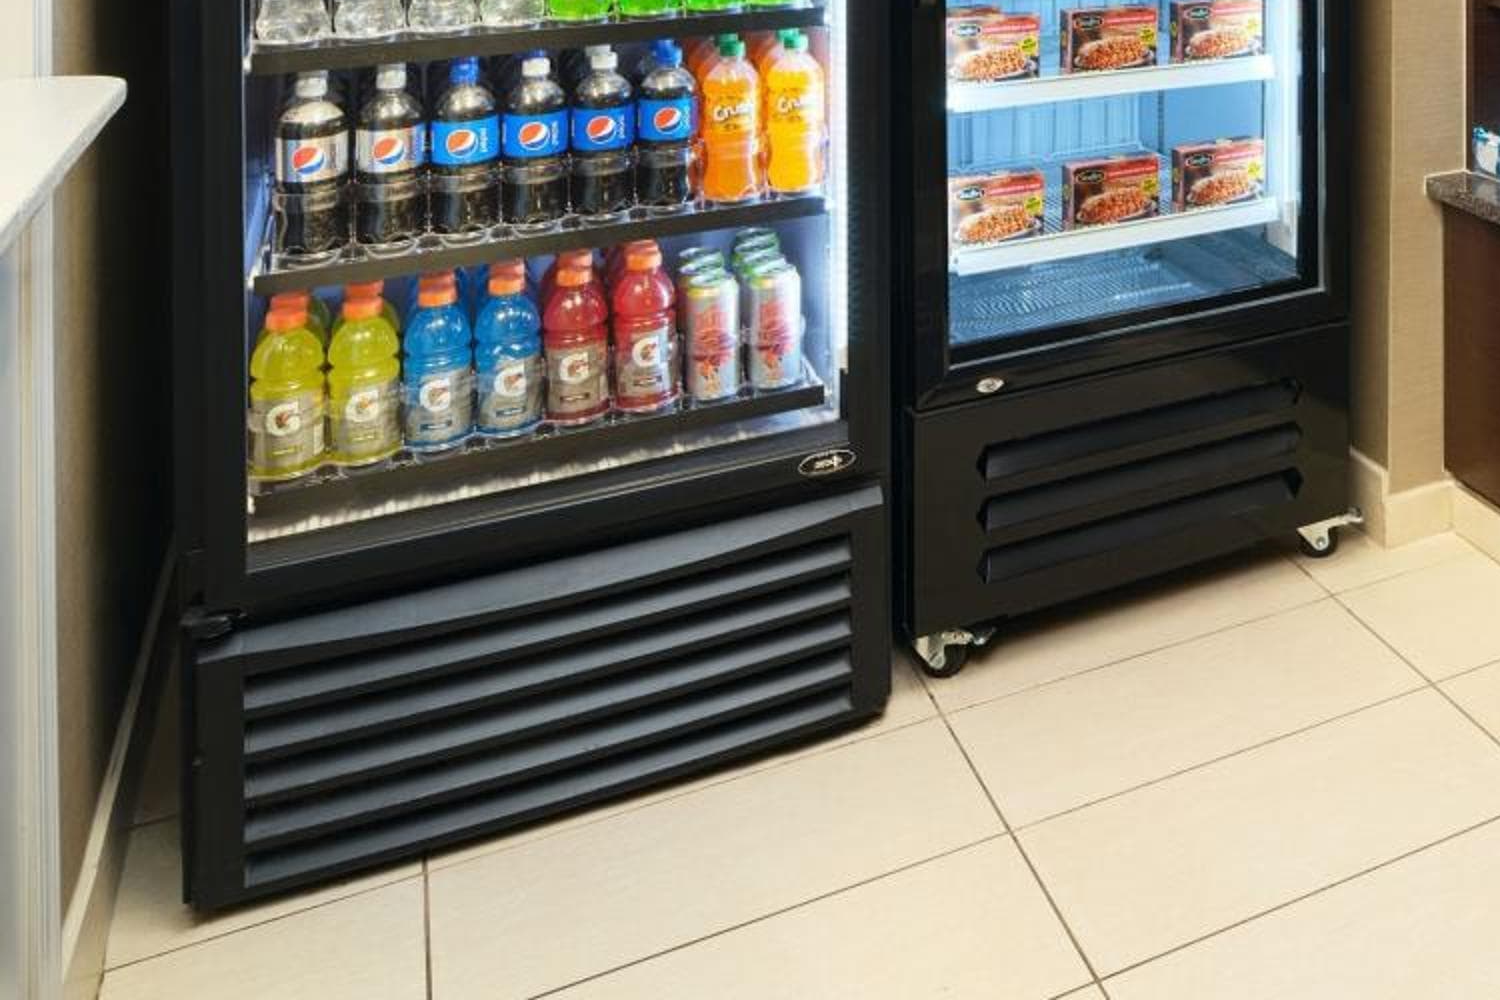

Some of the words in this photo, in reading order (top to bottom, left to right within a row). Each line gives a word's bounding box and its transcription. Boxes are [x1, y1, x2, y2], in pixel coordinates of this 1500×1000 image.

[632, 336, 660, 367] G
[494, 362, 527, 397] G
[559, 352, 590, 385] G
[345, 389, 380, 422] G
[420, 378, 451, 412] G
[266, 400, 300, 436] G
